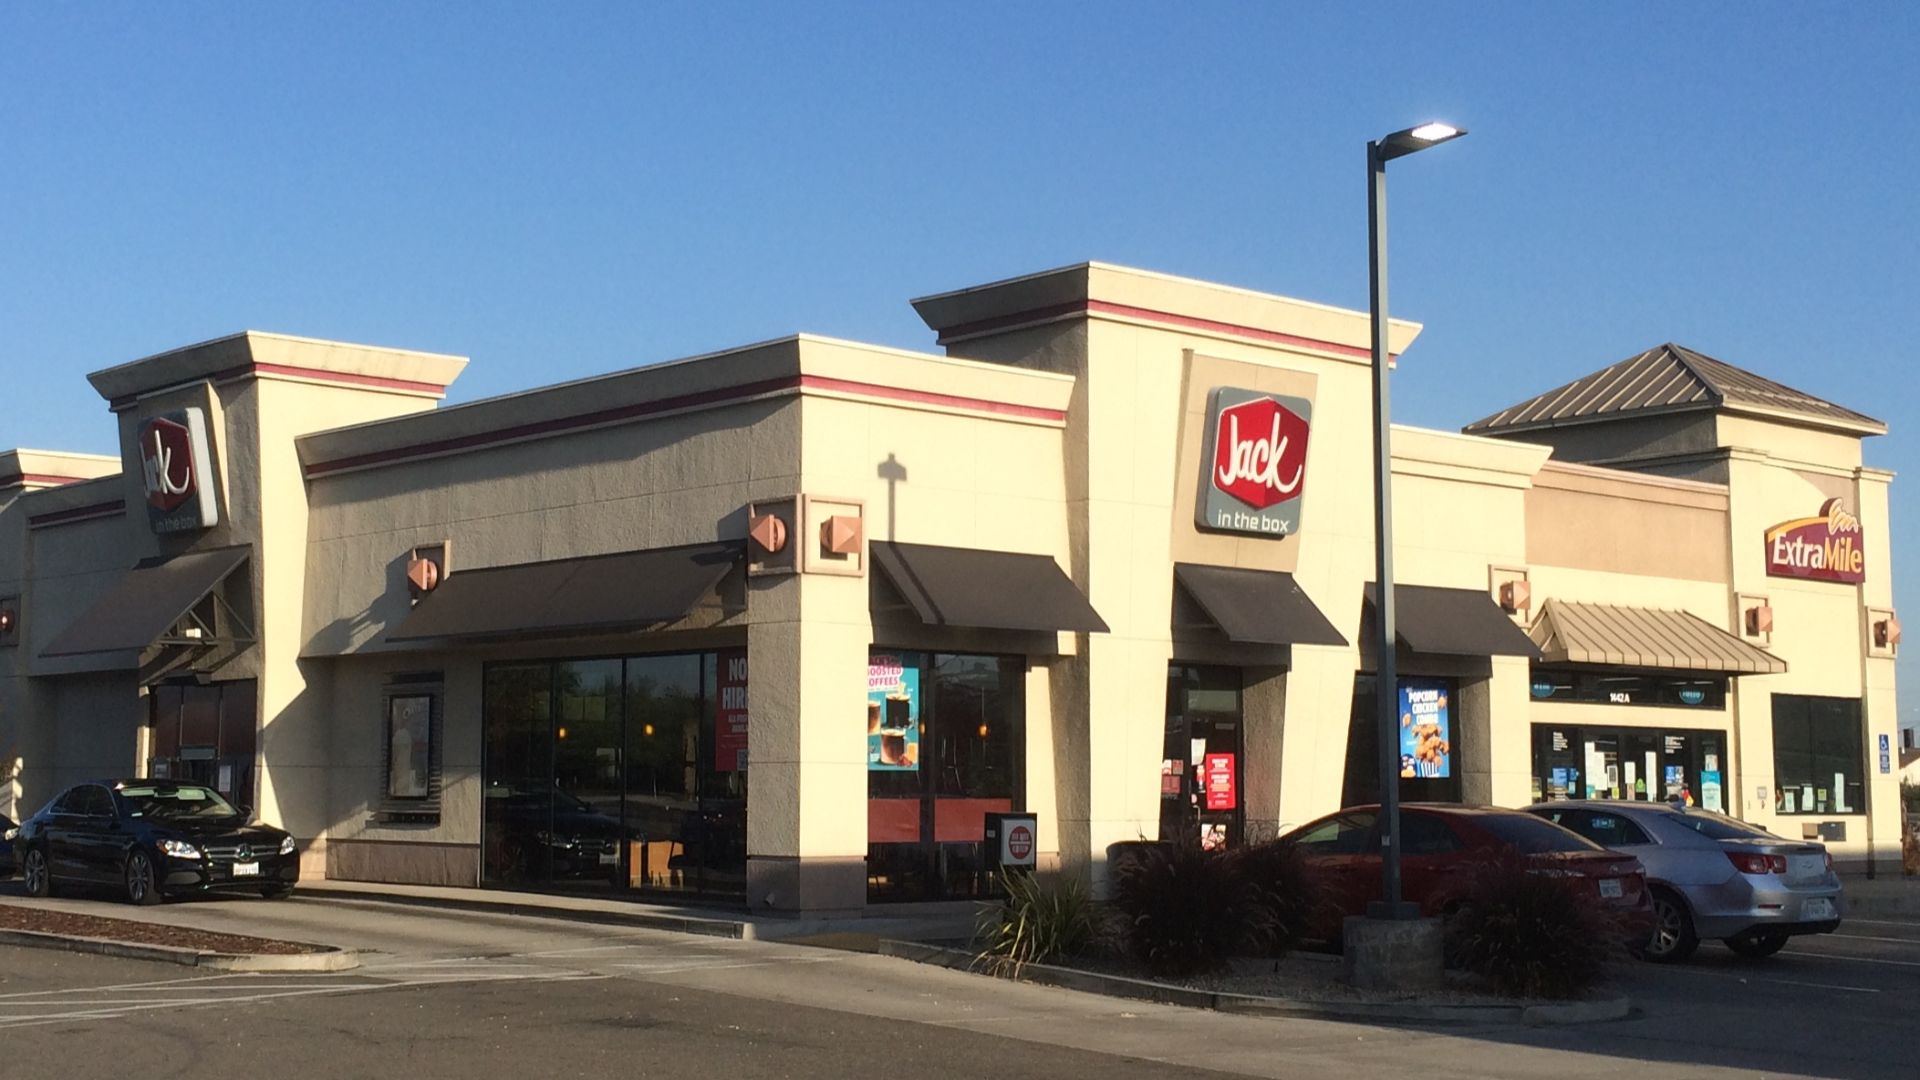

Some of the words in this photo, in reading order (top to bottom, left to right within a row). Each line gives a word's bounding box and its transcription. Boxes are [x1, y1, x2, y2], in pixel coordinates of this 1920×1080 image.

[1218, 411, 1303, 493] Jack
[1217, 509, 1231, 526] in
[1234, 511, 1258, 529] the
[1261, 514, 1289, 532] box
[1772, 532, 1863, 574] ExtraMile
[867, 666, 902, 677] OOSTED
